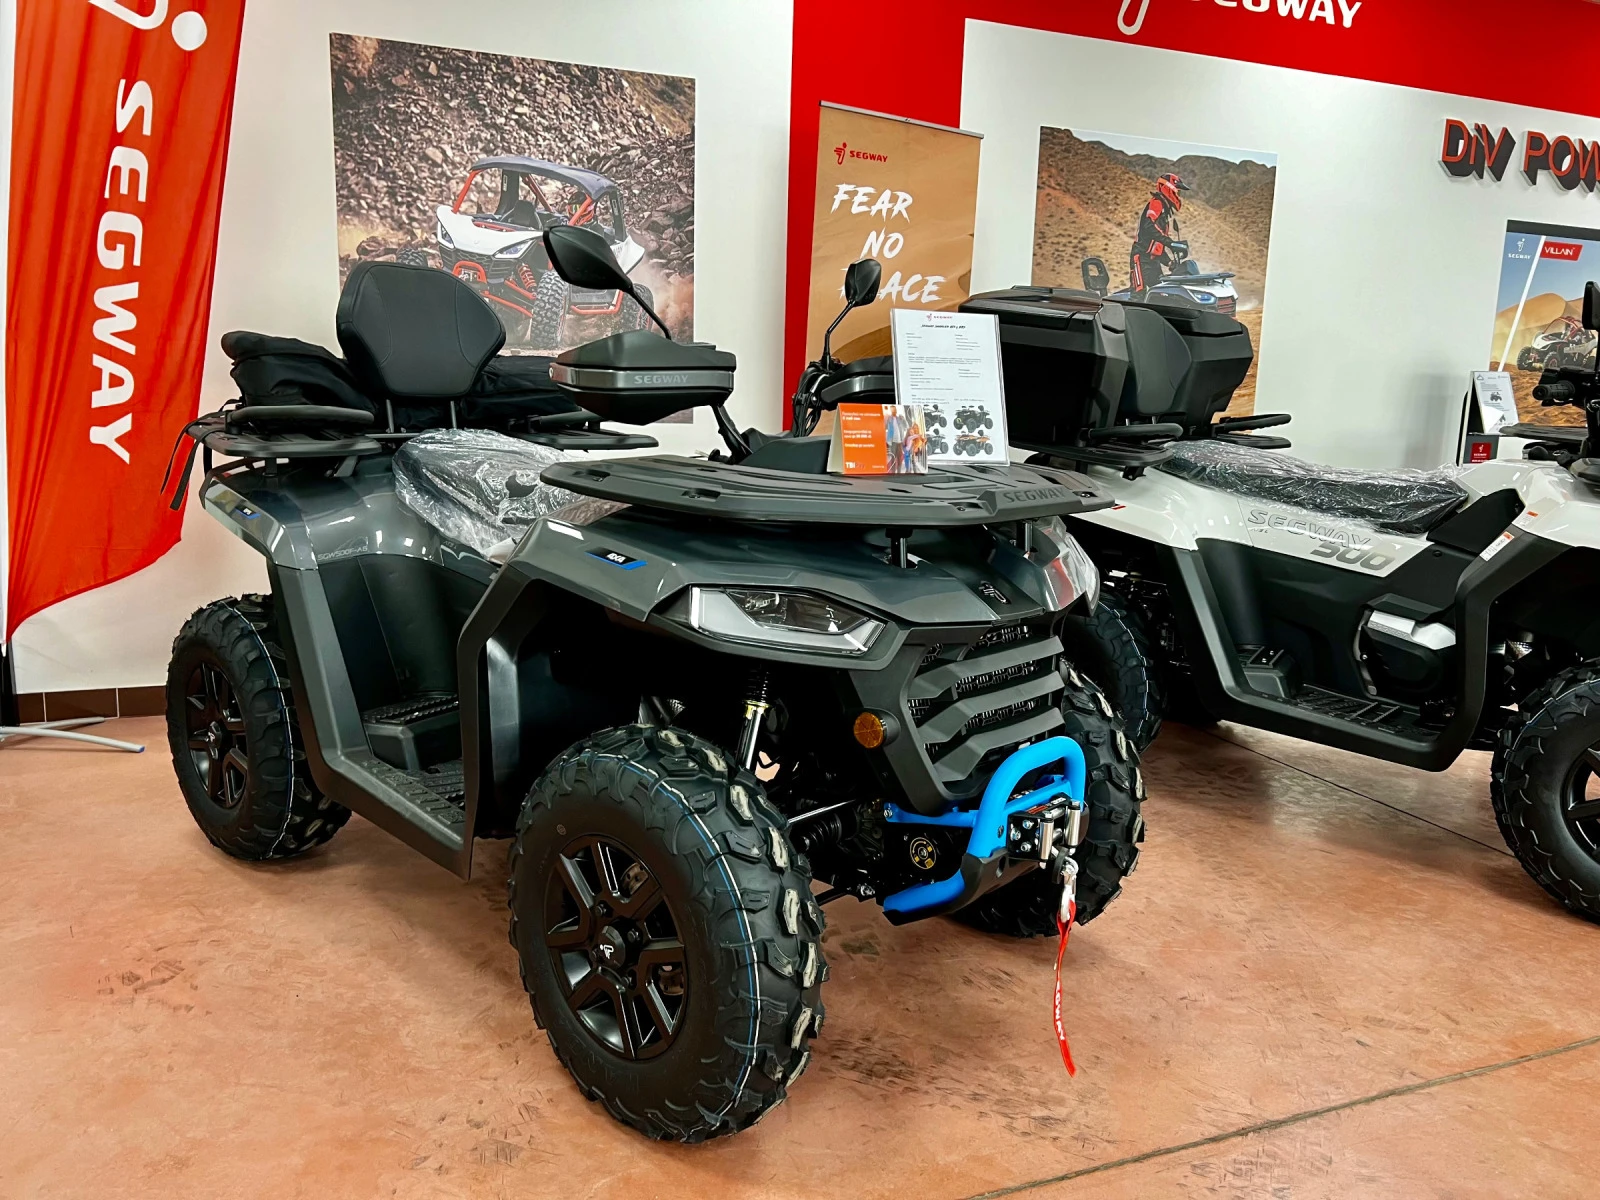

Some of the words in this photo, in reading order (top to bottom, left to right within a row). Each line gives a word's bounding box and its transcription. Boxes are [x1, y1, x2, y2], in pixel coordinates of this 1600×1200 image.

[849, 150, 888, 163] SEGWAY
[831, 183, 914, 224] FEAR
[859, 226, 904, 260] NO
[1544, 246, 1574, 257] VILLAIN
[89, 78, 153, 465] SEGWAY
[838, 268, 947, 305] ACE
[634, 374, 689, 384] SEGWAY
[1003, 487, 1067, 502] SEGWAY
[1248, 509, 1371, 551] SEGWAY
[1311, 541, 1395, 571] 500
